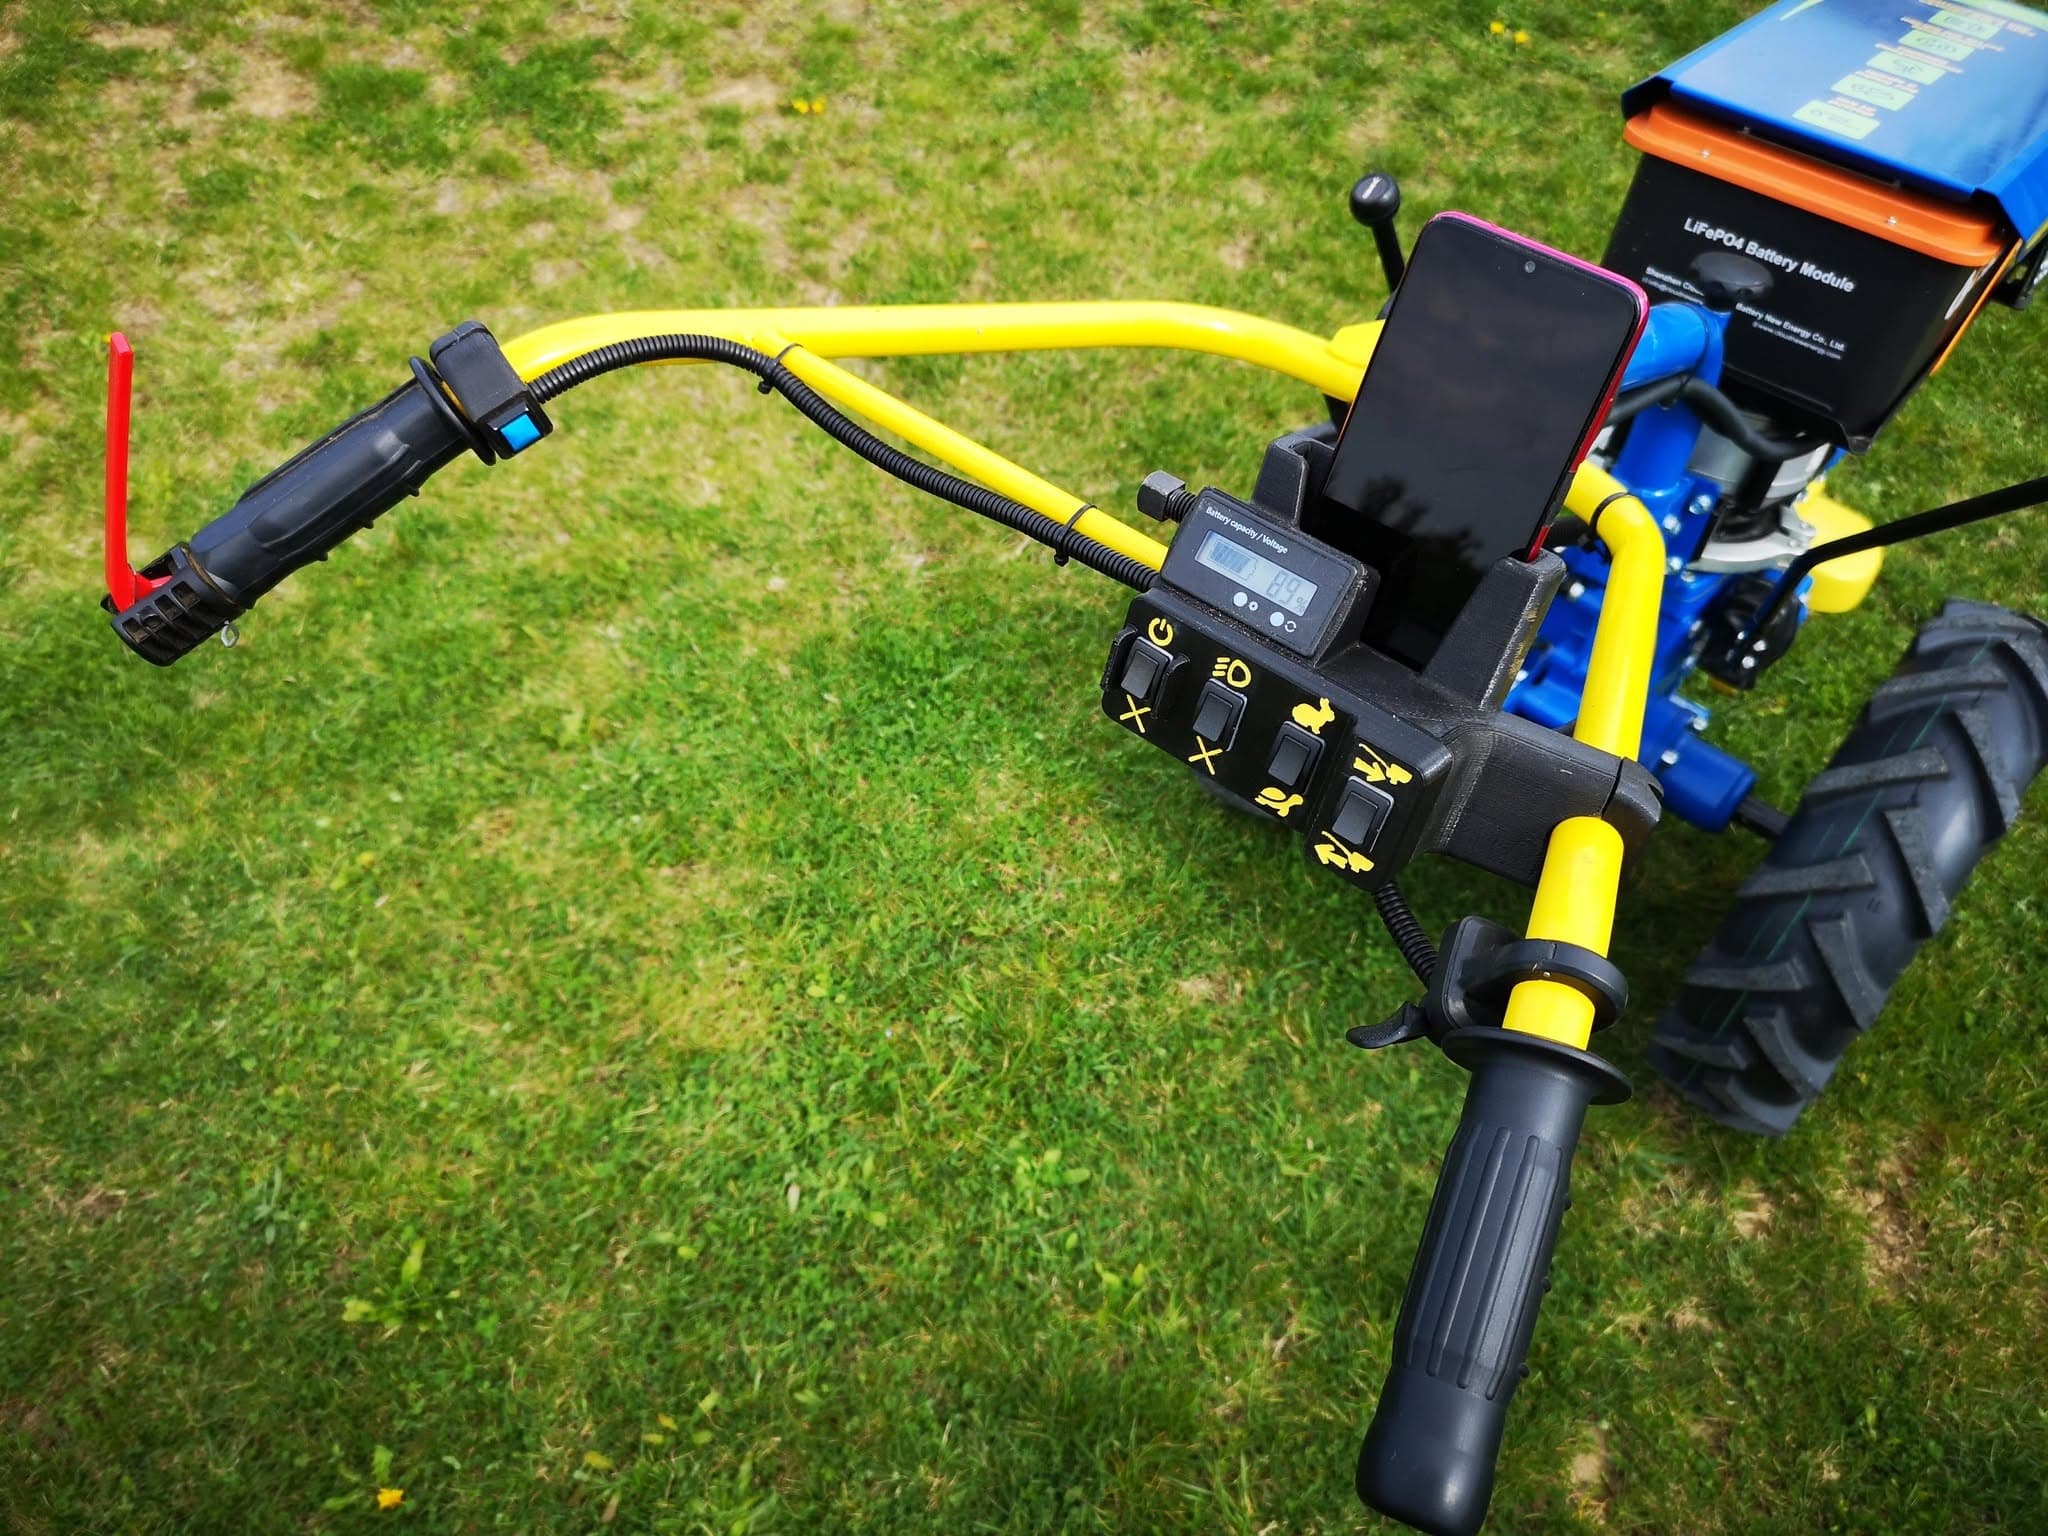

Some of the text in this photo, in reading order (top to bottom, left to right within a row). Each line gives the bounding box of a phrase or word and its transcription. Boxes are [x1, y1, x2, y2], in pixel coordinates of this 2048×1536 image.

[1684, 217, 1855, 293] LiFePO4 Battery Module
[1736, 302, 1763, 320] Battery
[1764, 313, 1782, 326] New
[1783, 321, 1811, 339] Energy
[1206, 506, 1231, 525] Battery
[1230, 520, 1257, 539] capacity
[1262, 534, 1288, 554] Voltage
